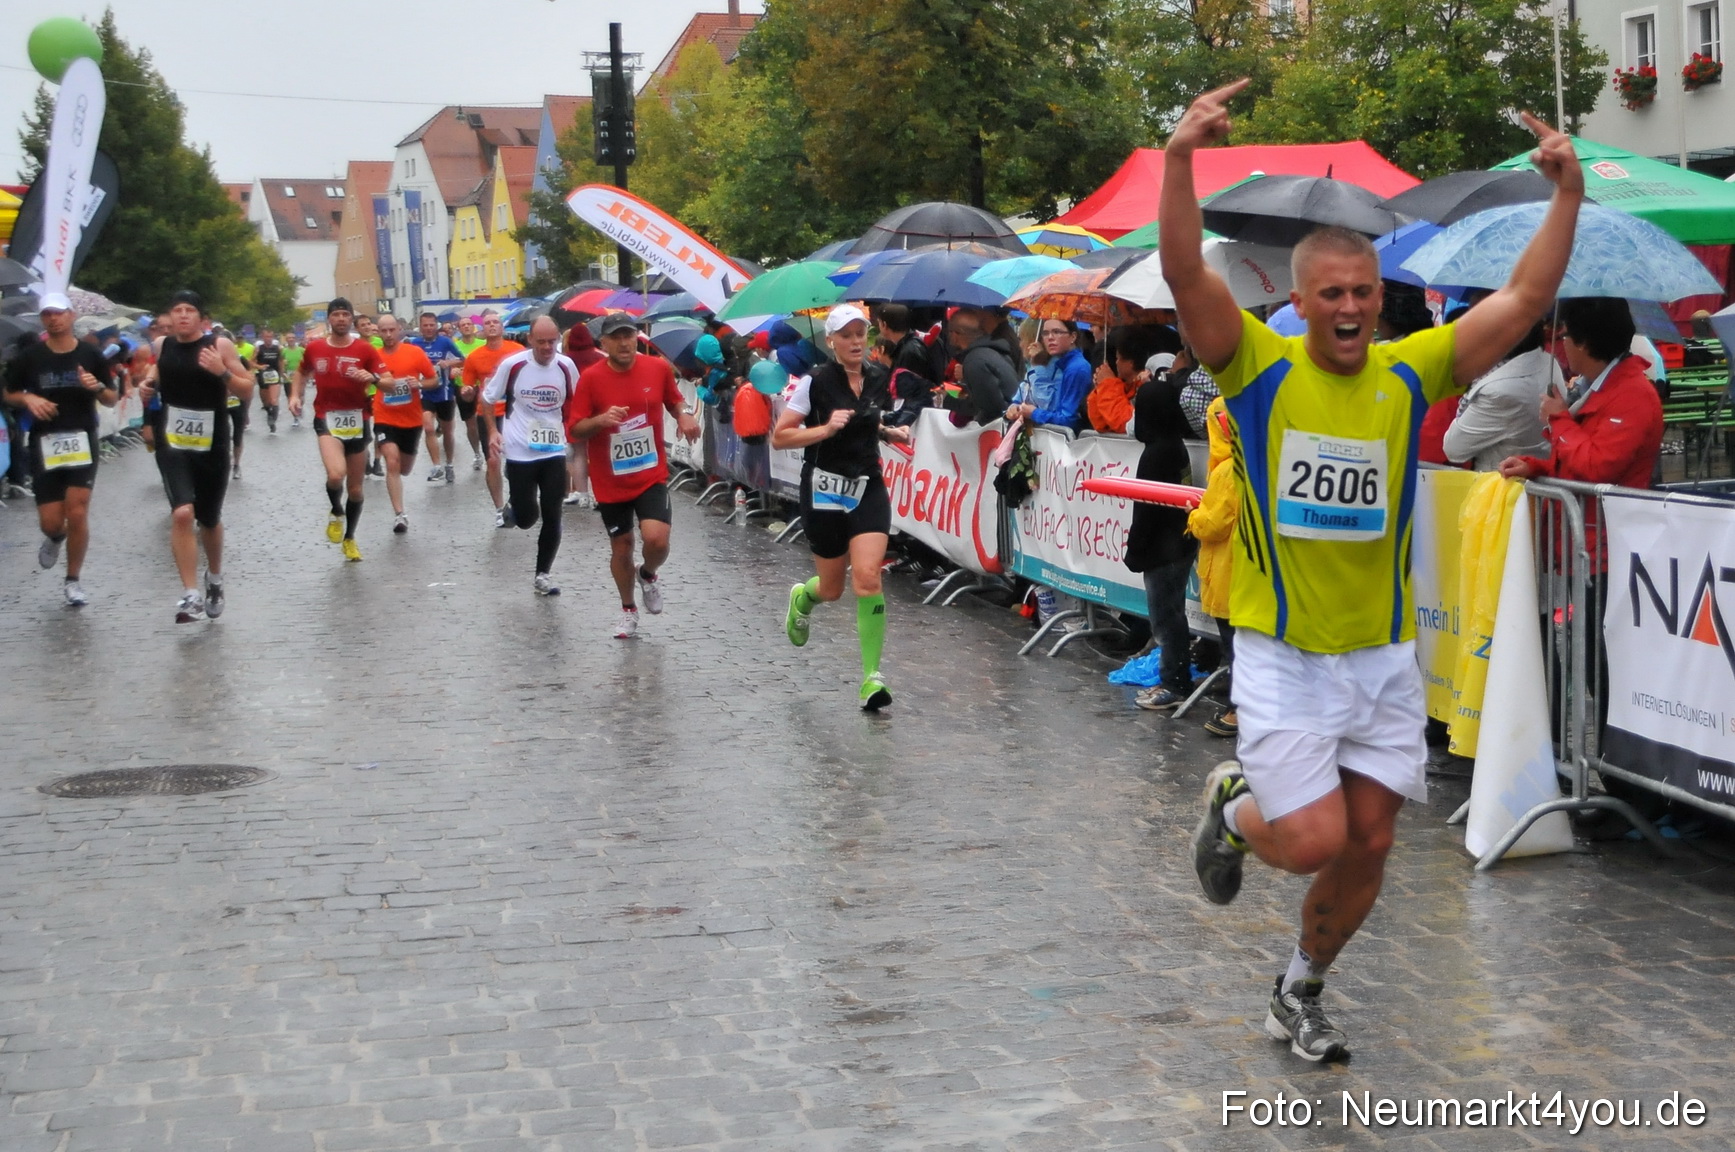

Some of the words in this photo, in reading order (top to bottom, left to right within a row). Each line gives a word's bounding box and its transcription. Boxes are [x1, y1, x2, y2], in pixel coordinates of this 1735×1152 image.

[54, 220, 69, 274] Audi
[520, 389, 556, 397] GERHART
[175, 419, 204, 436] 244
[334, 416, 357, 428] 246
[531, 429, 560, 444] 3105
[52, 439, 80, 455] 248
[614, 438, 650, 460] 2031
[878, 438, 970, 538] erbank
[1288, 460, 1379, 505] 2606
[1302, 507, 1360, 527] Thomas
[1632, 690, 1717, 729] INTERNETLÖSUNGEN
